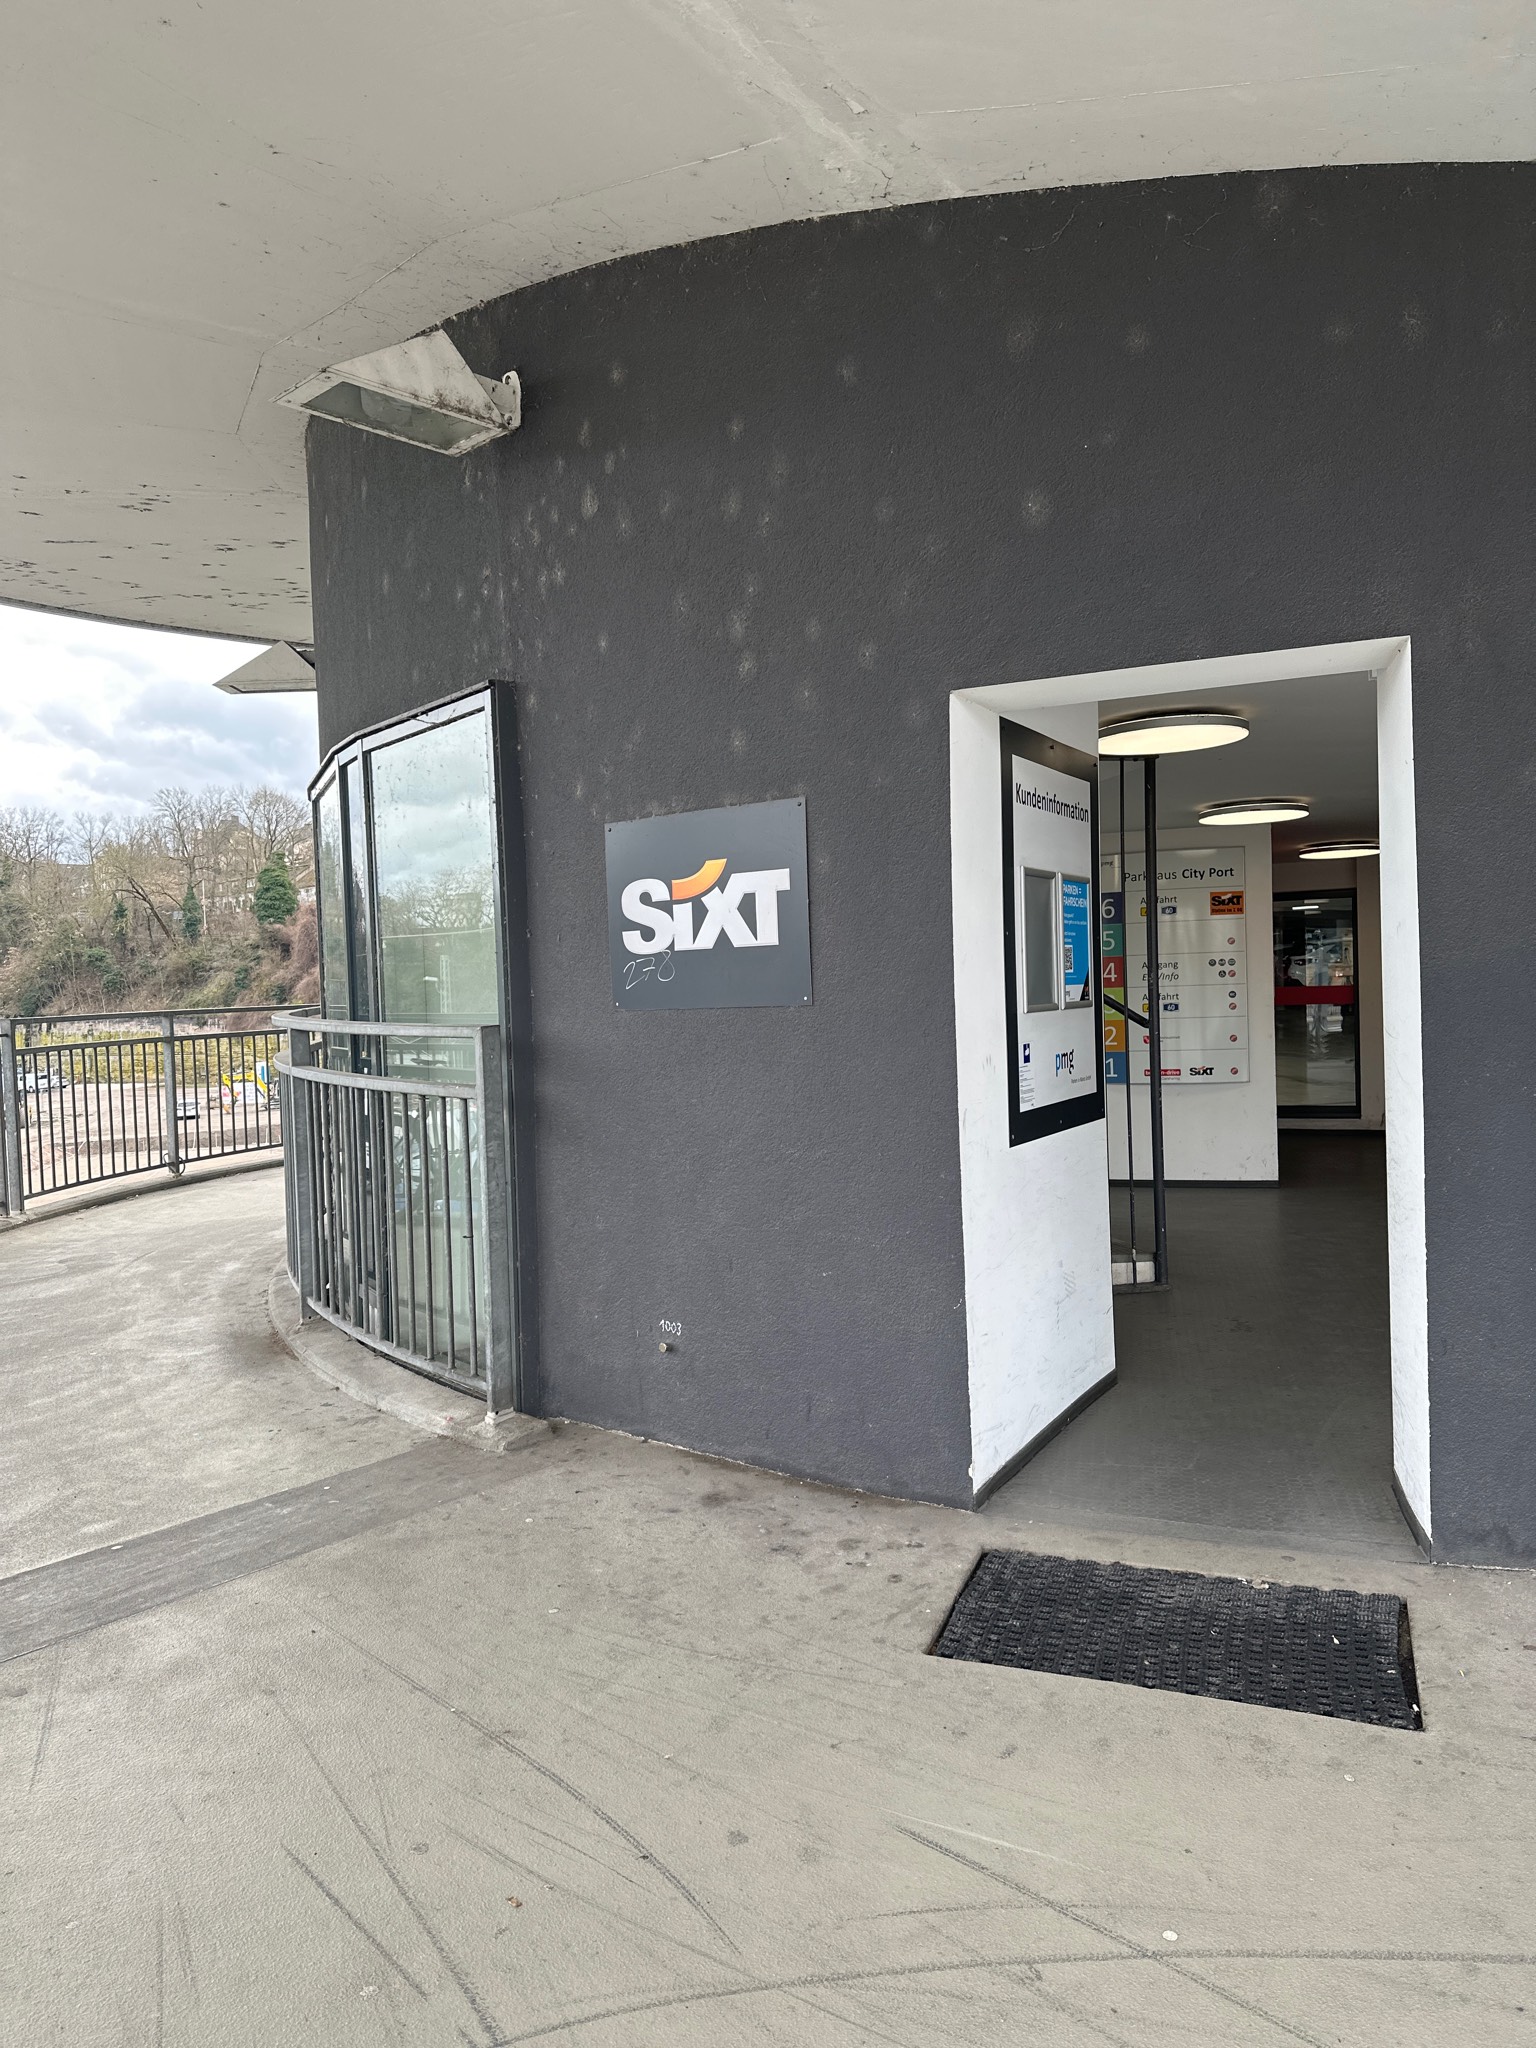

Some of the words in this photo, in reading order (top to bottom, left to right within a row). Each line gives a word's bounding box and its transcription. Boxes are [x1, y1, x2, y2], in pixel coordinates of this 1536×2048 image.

[1015, 782, 1089, 823] Kundeninformation
[1124, 871, 1177, 882] Parkaus
[1181, 868, 1205, 880] City
[1208, 867, 1234, 878] Port
[1101, 898, 1115, 919] 6
[1102, 930, 1115, 951] 5
[1103, 962, 1118, 982] 4
[1104, 1026, 1118, 1046] 2
[1055, 1048, 1075, 1078] pmg
[1105, 1057, 1118, 1078] 1
[658, 1319, 682, 1336] 1003
